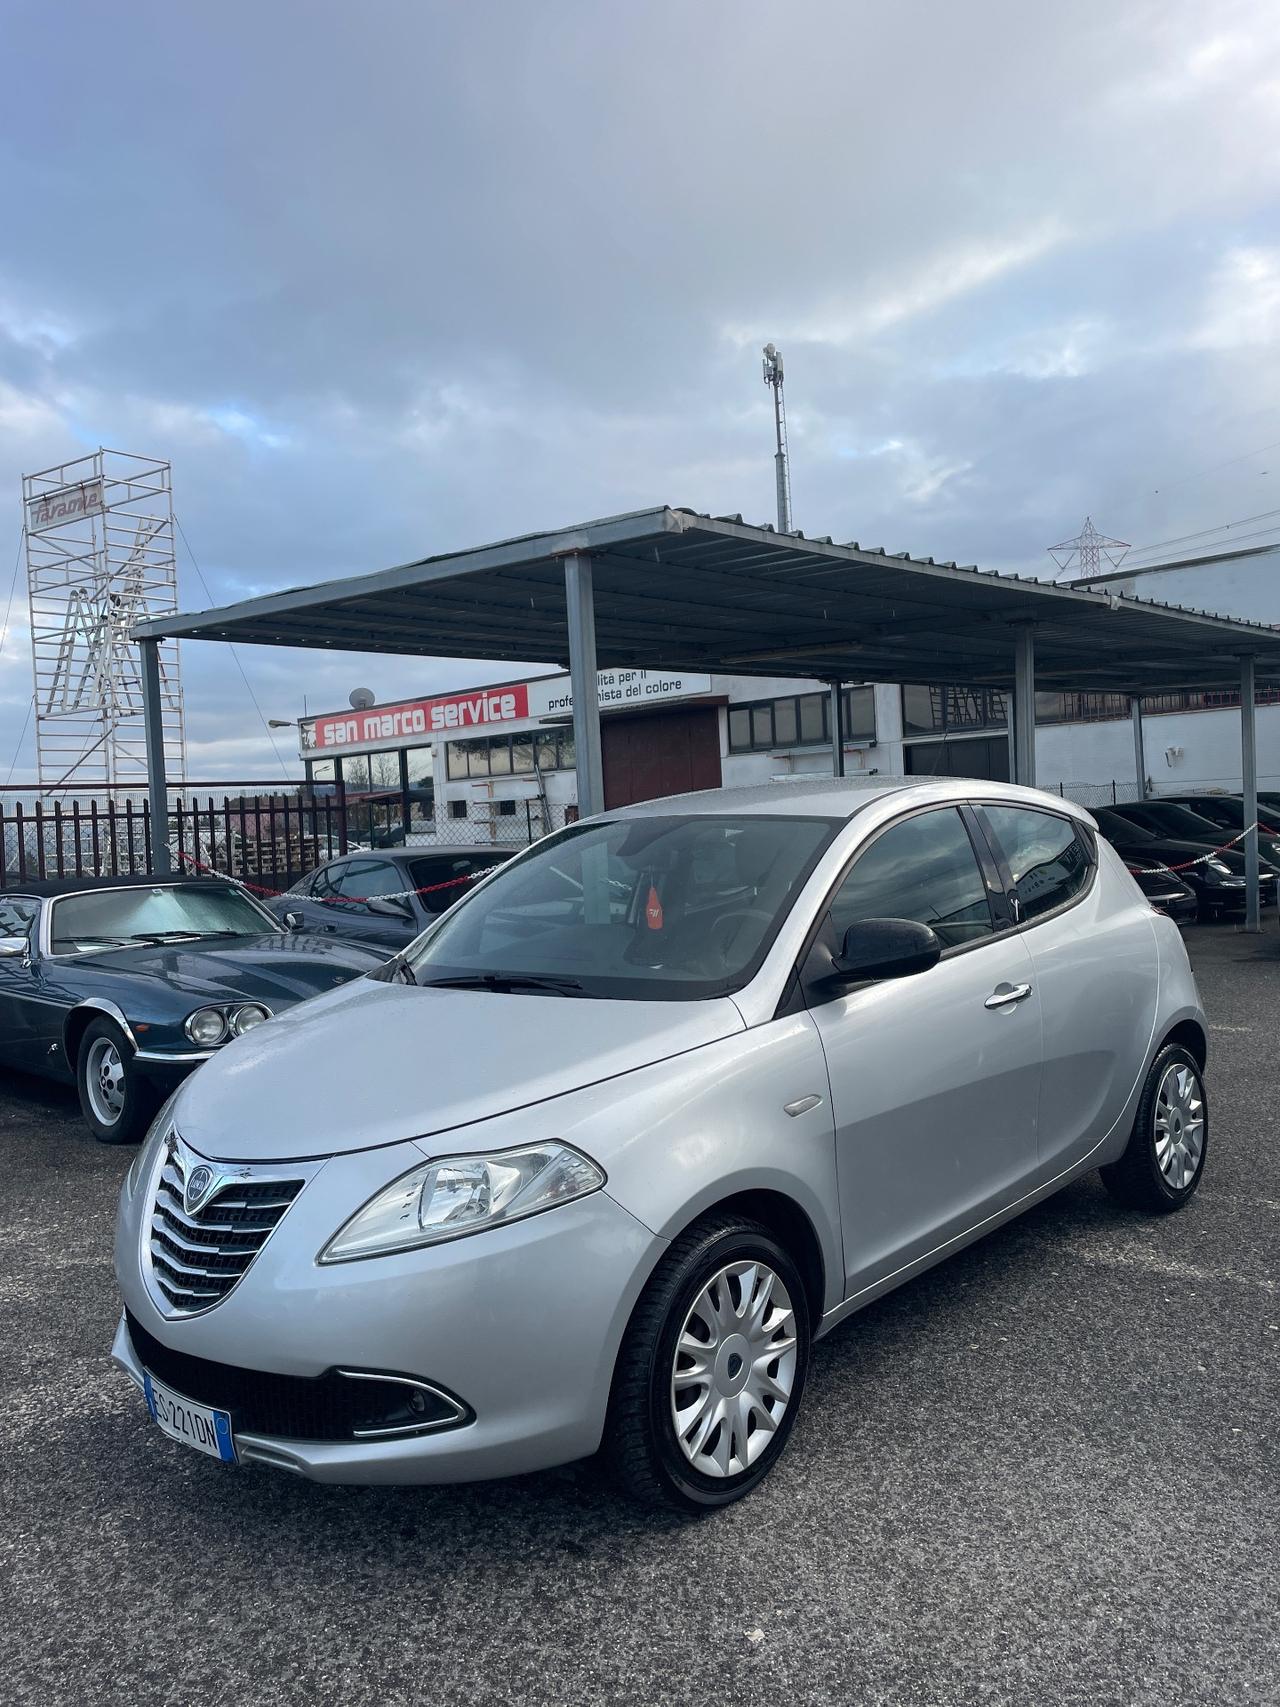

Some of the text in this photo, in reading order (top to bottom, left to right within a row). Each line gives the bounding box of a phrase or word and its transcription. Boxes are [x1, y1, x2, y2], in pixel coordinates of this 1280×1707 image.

[619, 671, 637, 685] per
[626, 683, 642, 697] del
[645, 679, 682, 695] colore
[324, 692, 516, 745] san marco service
